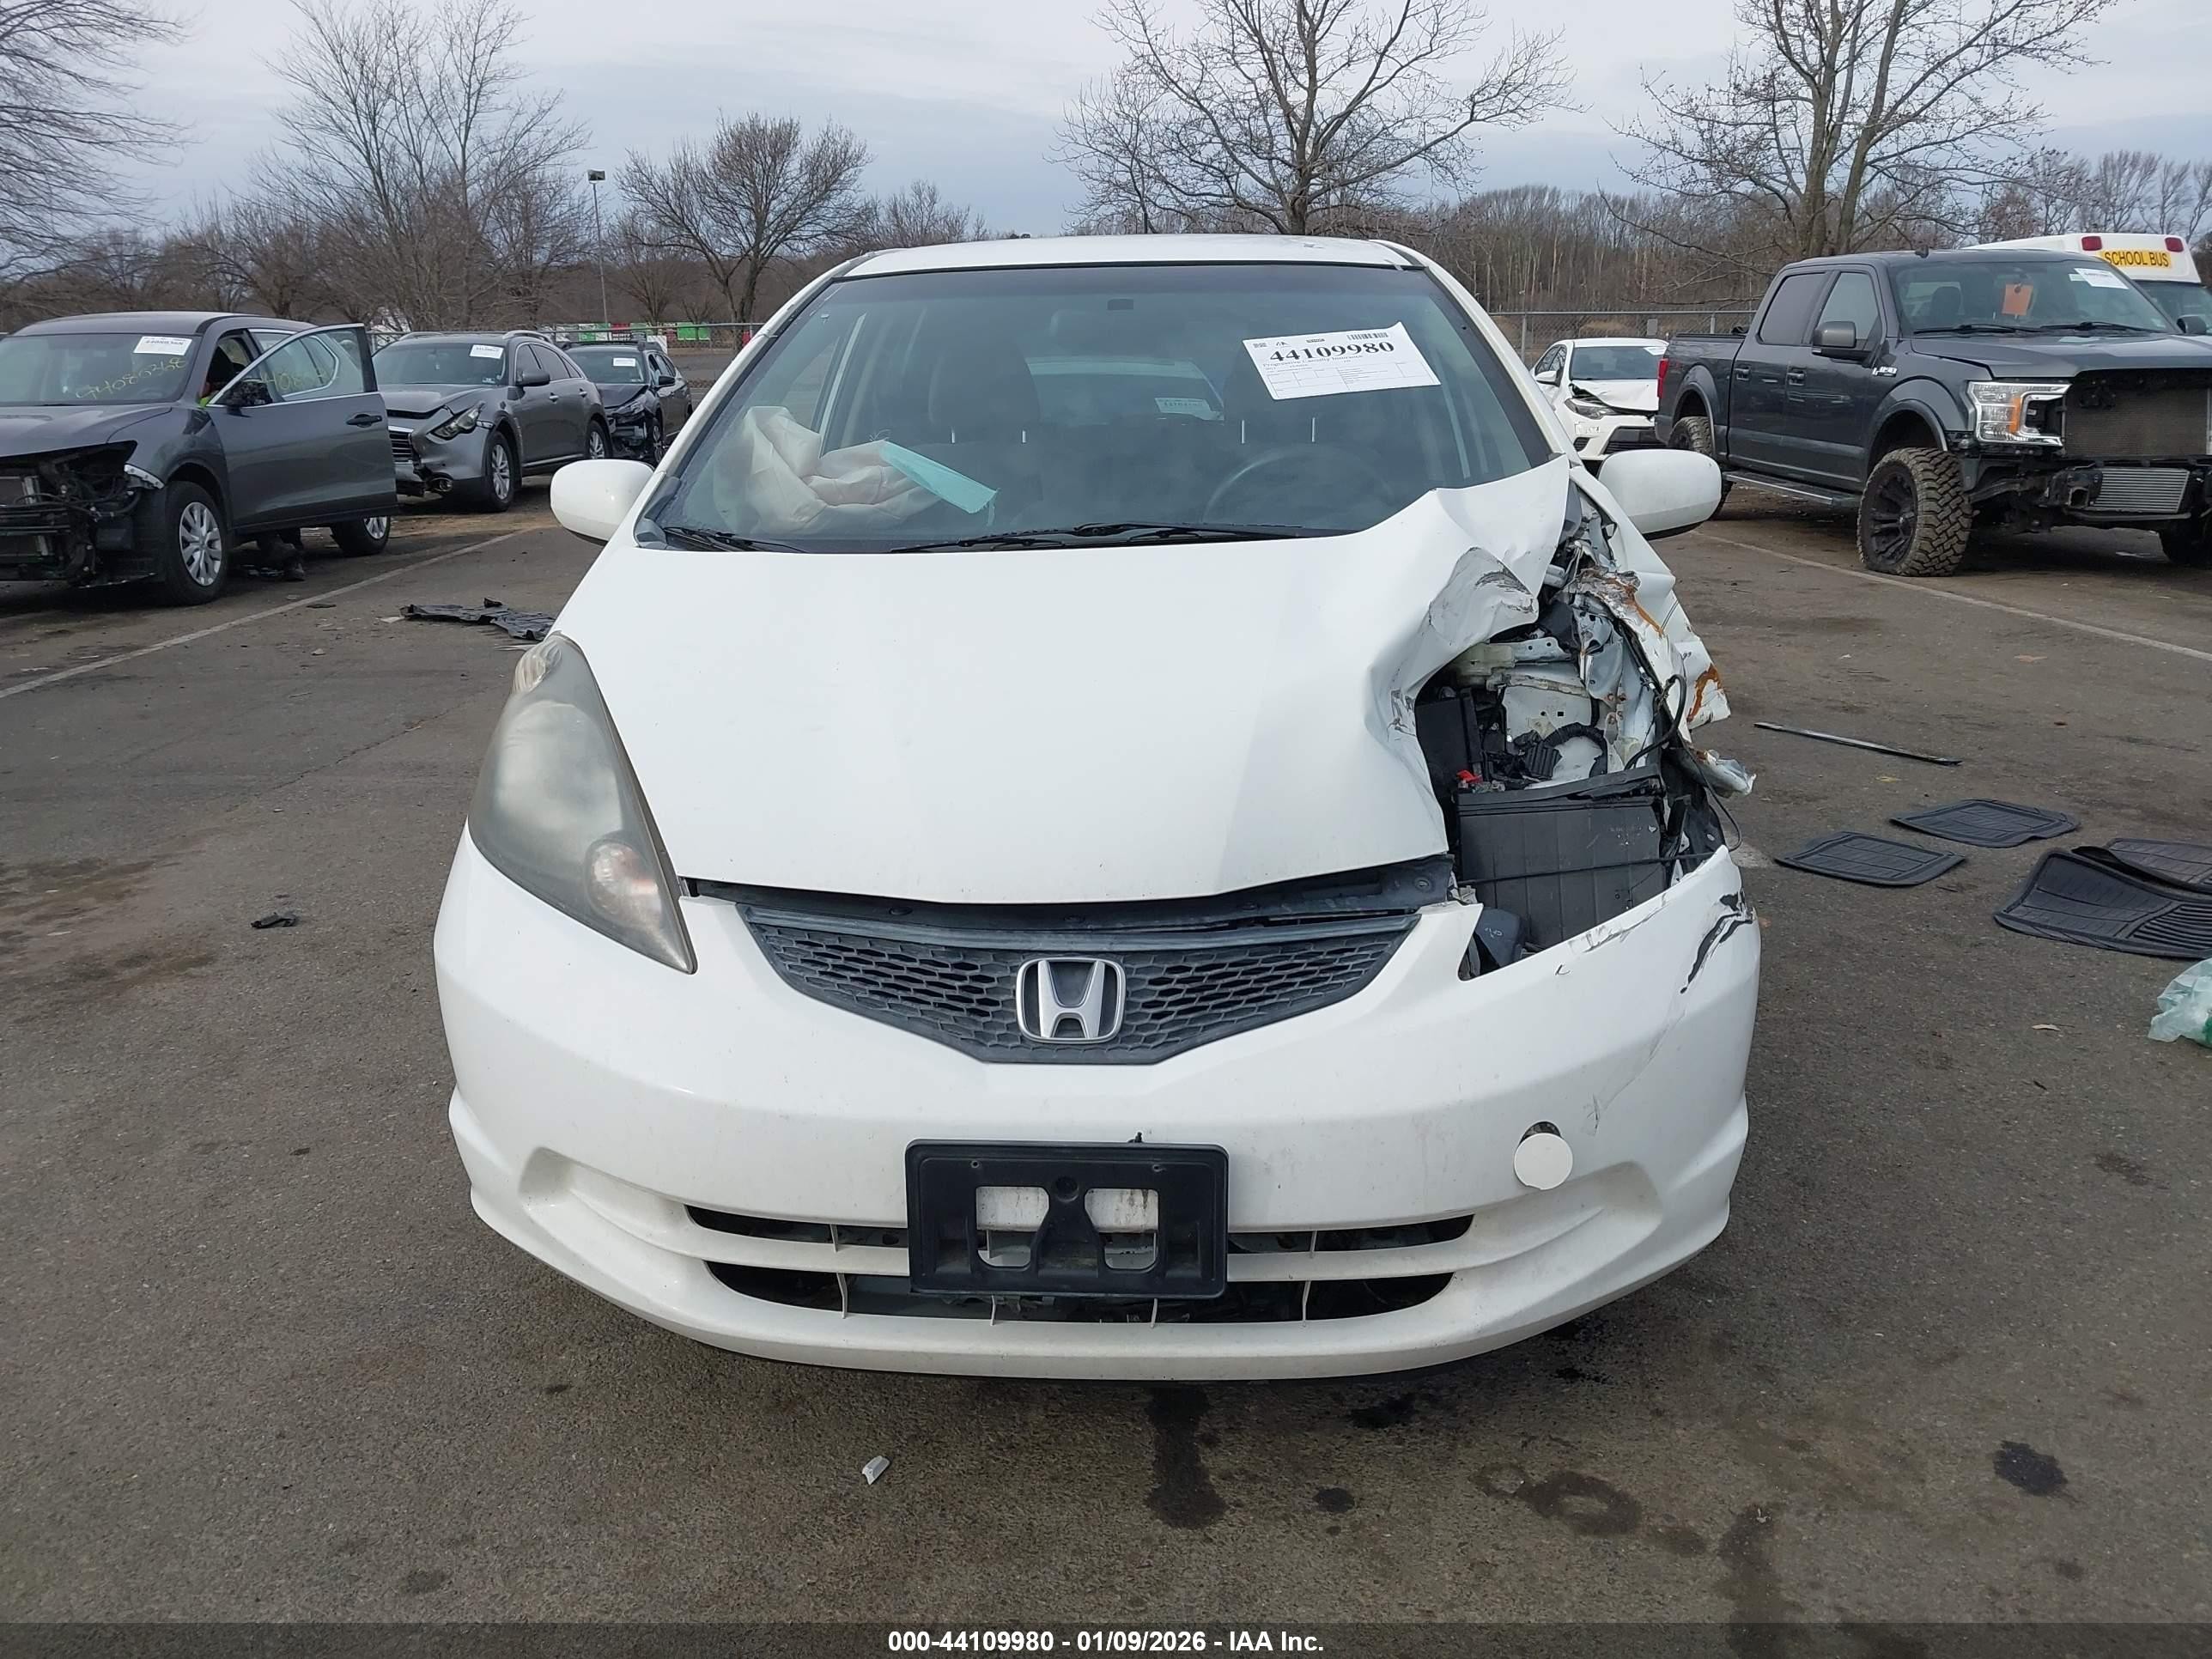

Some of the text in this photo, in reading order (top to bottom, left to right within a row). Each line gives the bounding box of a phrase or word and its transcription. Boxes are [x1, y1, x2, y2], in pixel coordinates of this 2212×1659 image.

[2104, 251, 2169, 267] SCHOOL BUS
[1269, 341, 1395, 362] 44109980
